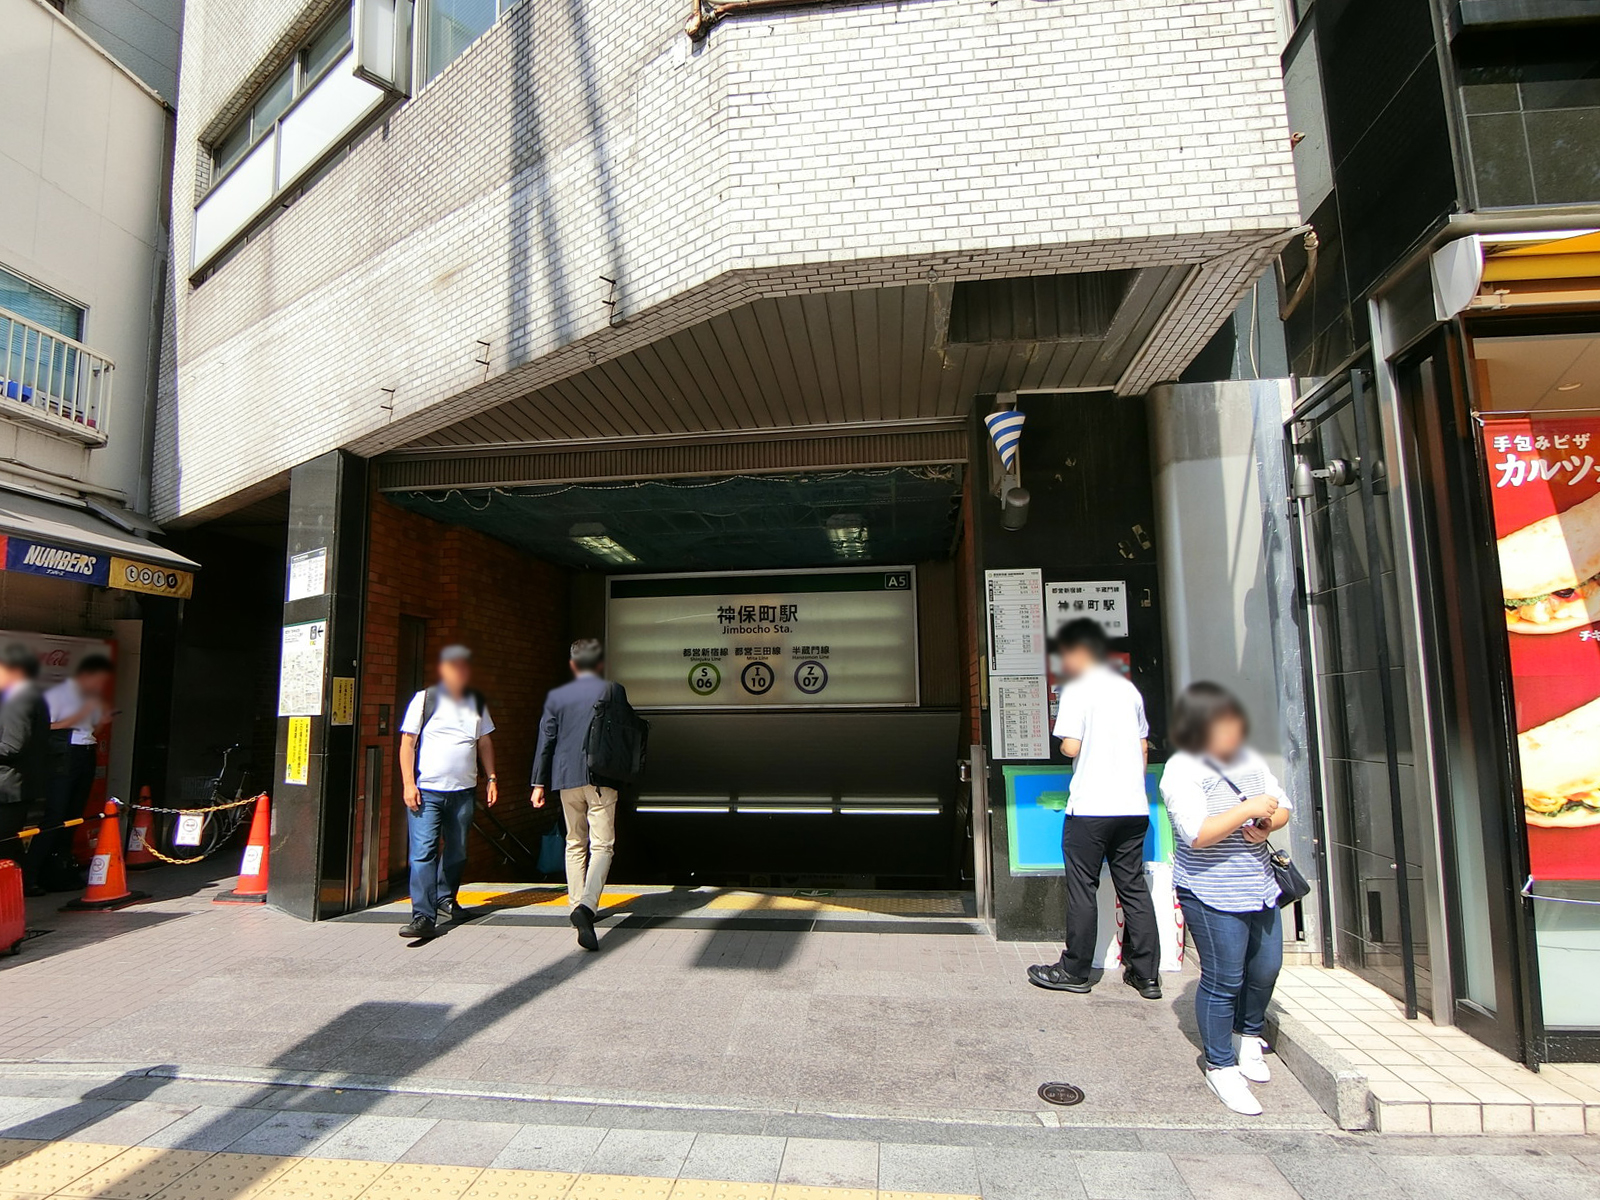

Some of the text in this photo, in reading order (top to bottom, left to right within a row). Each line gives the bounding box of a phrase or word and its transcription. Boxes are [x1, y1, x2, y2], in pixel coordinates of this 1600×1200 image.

[1493, 433, 1590, 452] 手包みピザ
[23, 545, 97, 575] NUMBERS
[127, 566, 177, 587] toto
[888, 576, 906, 587] A5
[717, 604, 799, 624] 神保町駅
[722, 624, 793, 635] Jimbocho Sta.
[683, 645, 830, 657] 都営新宿線 都営三田線 半蔵門線
[701, 668, 708, 677] S
[754, 667, 760, 676] I
[807, 666, 815, 676] Z
[696, 678, 713, 689] 06
[751, 677, 766, 688] 10
[803, 676, 819, 687] 07
